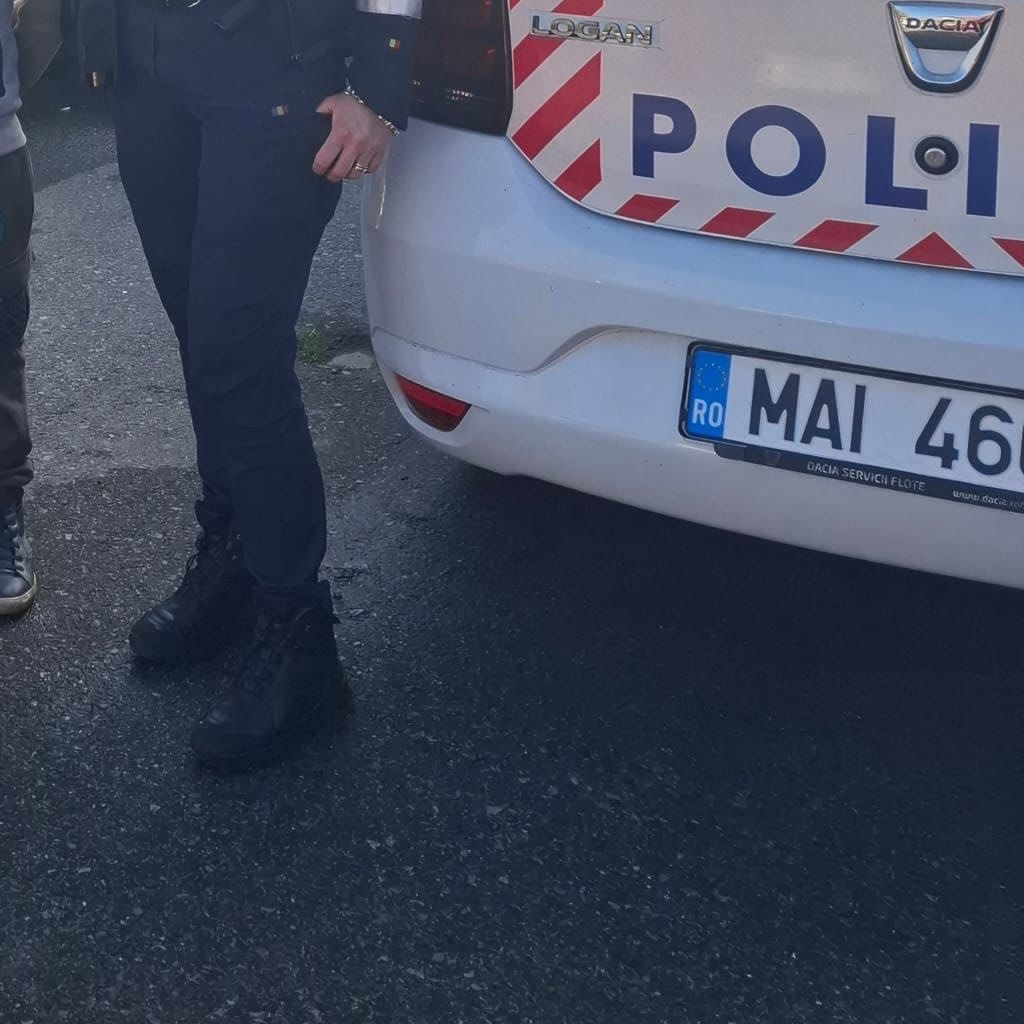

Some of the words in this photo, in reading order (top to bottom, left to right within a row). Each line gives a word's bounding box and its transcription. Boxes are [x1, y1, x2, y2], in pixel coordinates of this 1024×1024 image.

[531, 15, 654, 46] LOGAN
[906, 17, 982, 33] DACIA
[632, 93, 1000, 217] POLI
[692, 399, 723, 429] RO
[748, 367, 866, 454] MAI
[914, 397, 1024, 477] 46
[807, 461, 839, 476] DACIA
[842, 467, 887, 485] SERVICII
[891, 477, 925, 492] FLOTE
